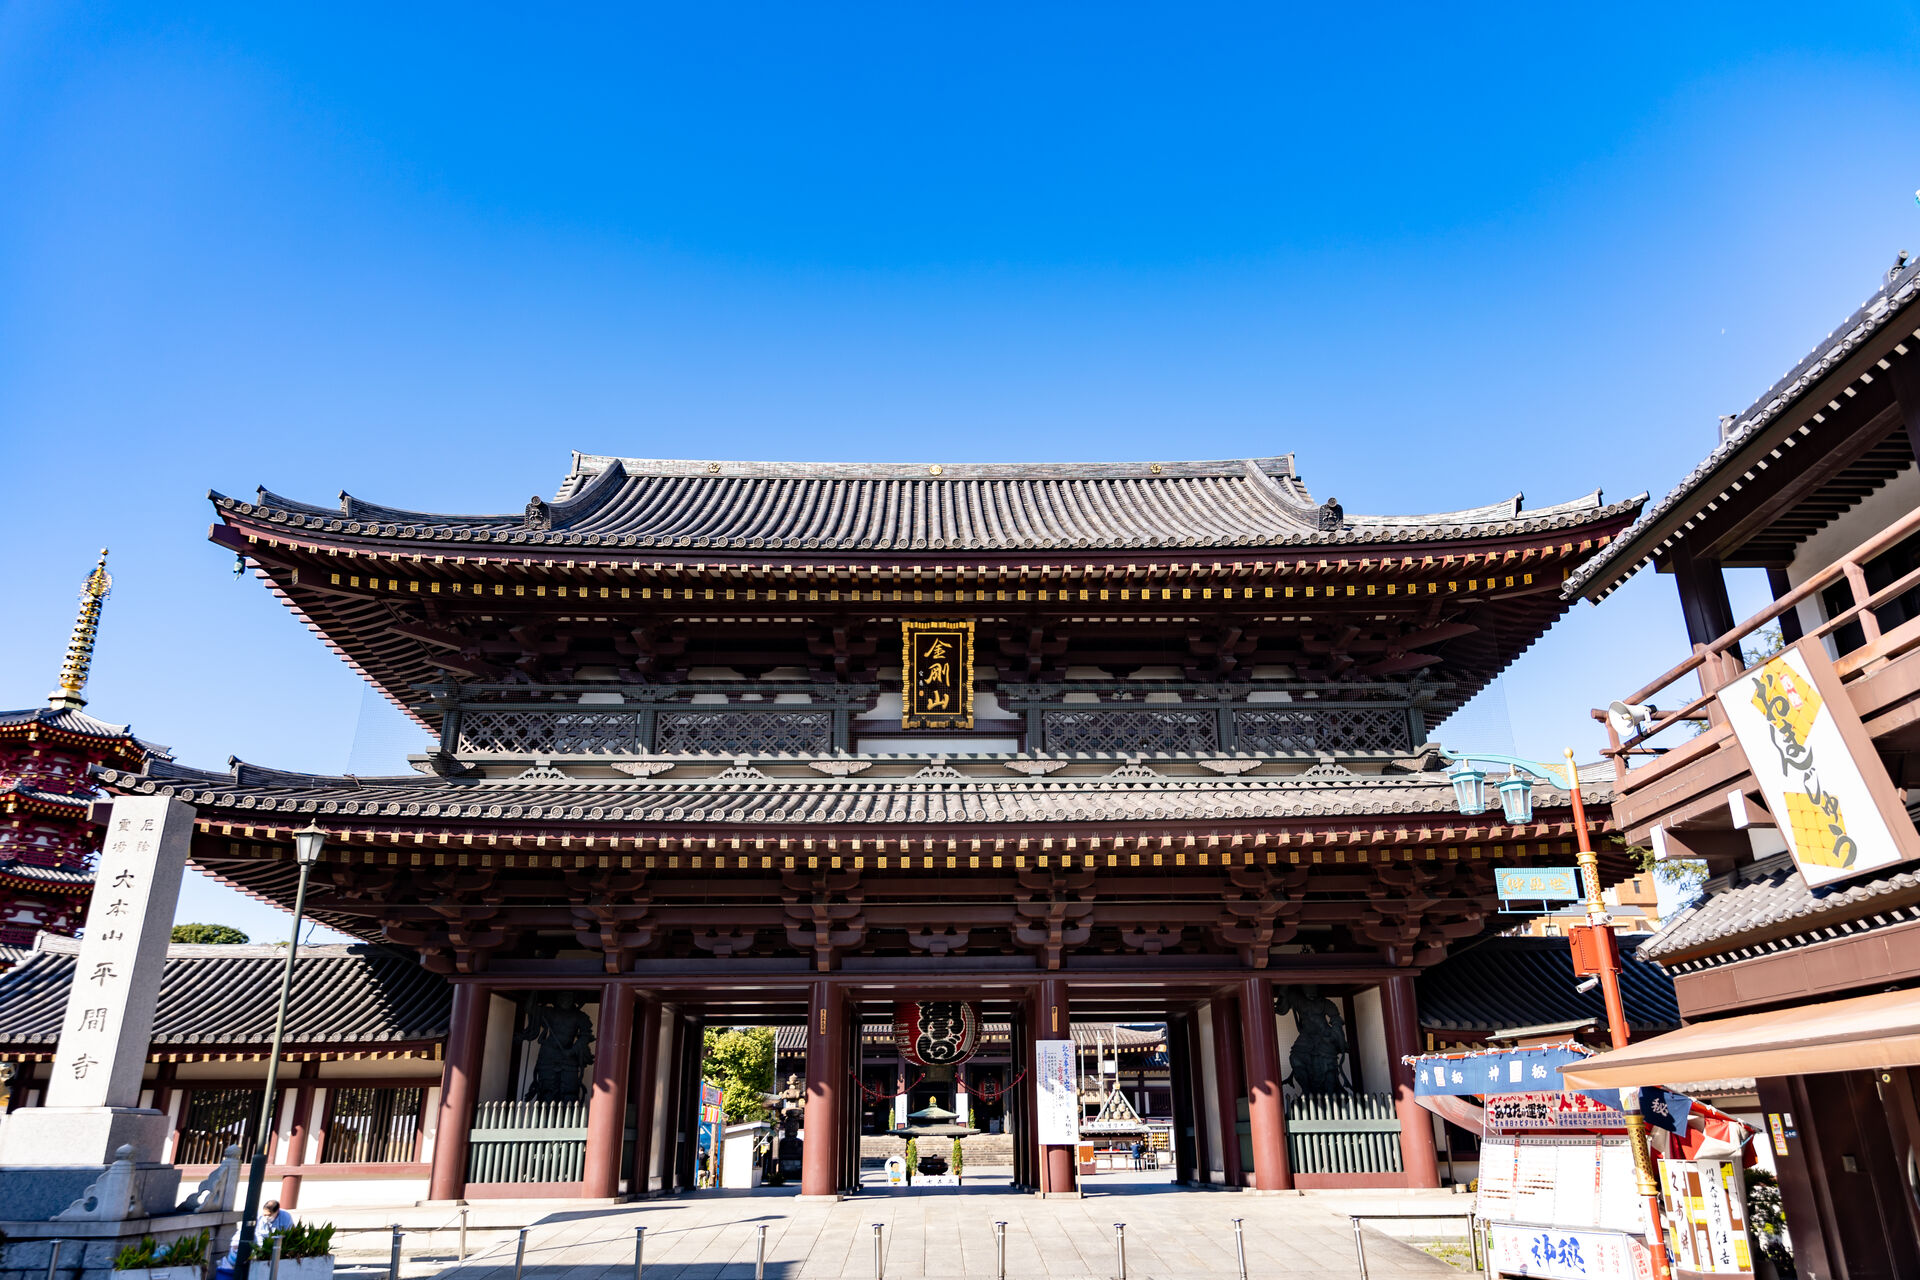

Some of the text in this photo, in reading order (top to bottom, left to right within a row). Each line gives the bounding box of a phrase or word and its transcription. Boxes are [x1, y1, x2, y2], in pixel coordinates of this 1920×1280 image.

[924, 638, 952, 710] 金剛山
[1751, 673, 1857, 869] おまんじゅう
[1488, 1064, 1500, 1082] 神
[1531, 1063, 1548, 1080] 秘
[1494, 1102, 1549, 1120] あなたの運勢
[1651, 1098, 1670, 1118] 秘
[1531, 1234, 1587, 1274] 神秘
